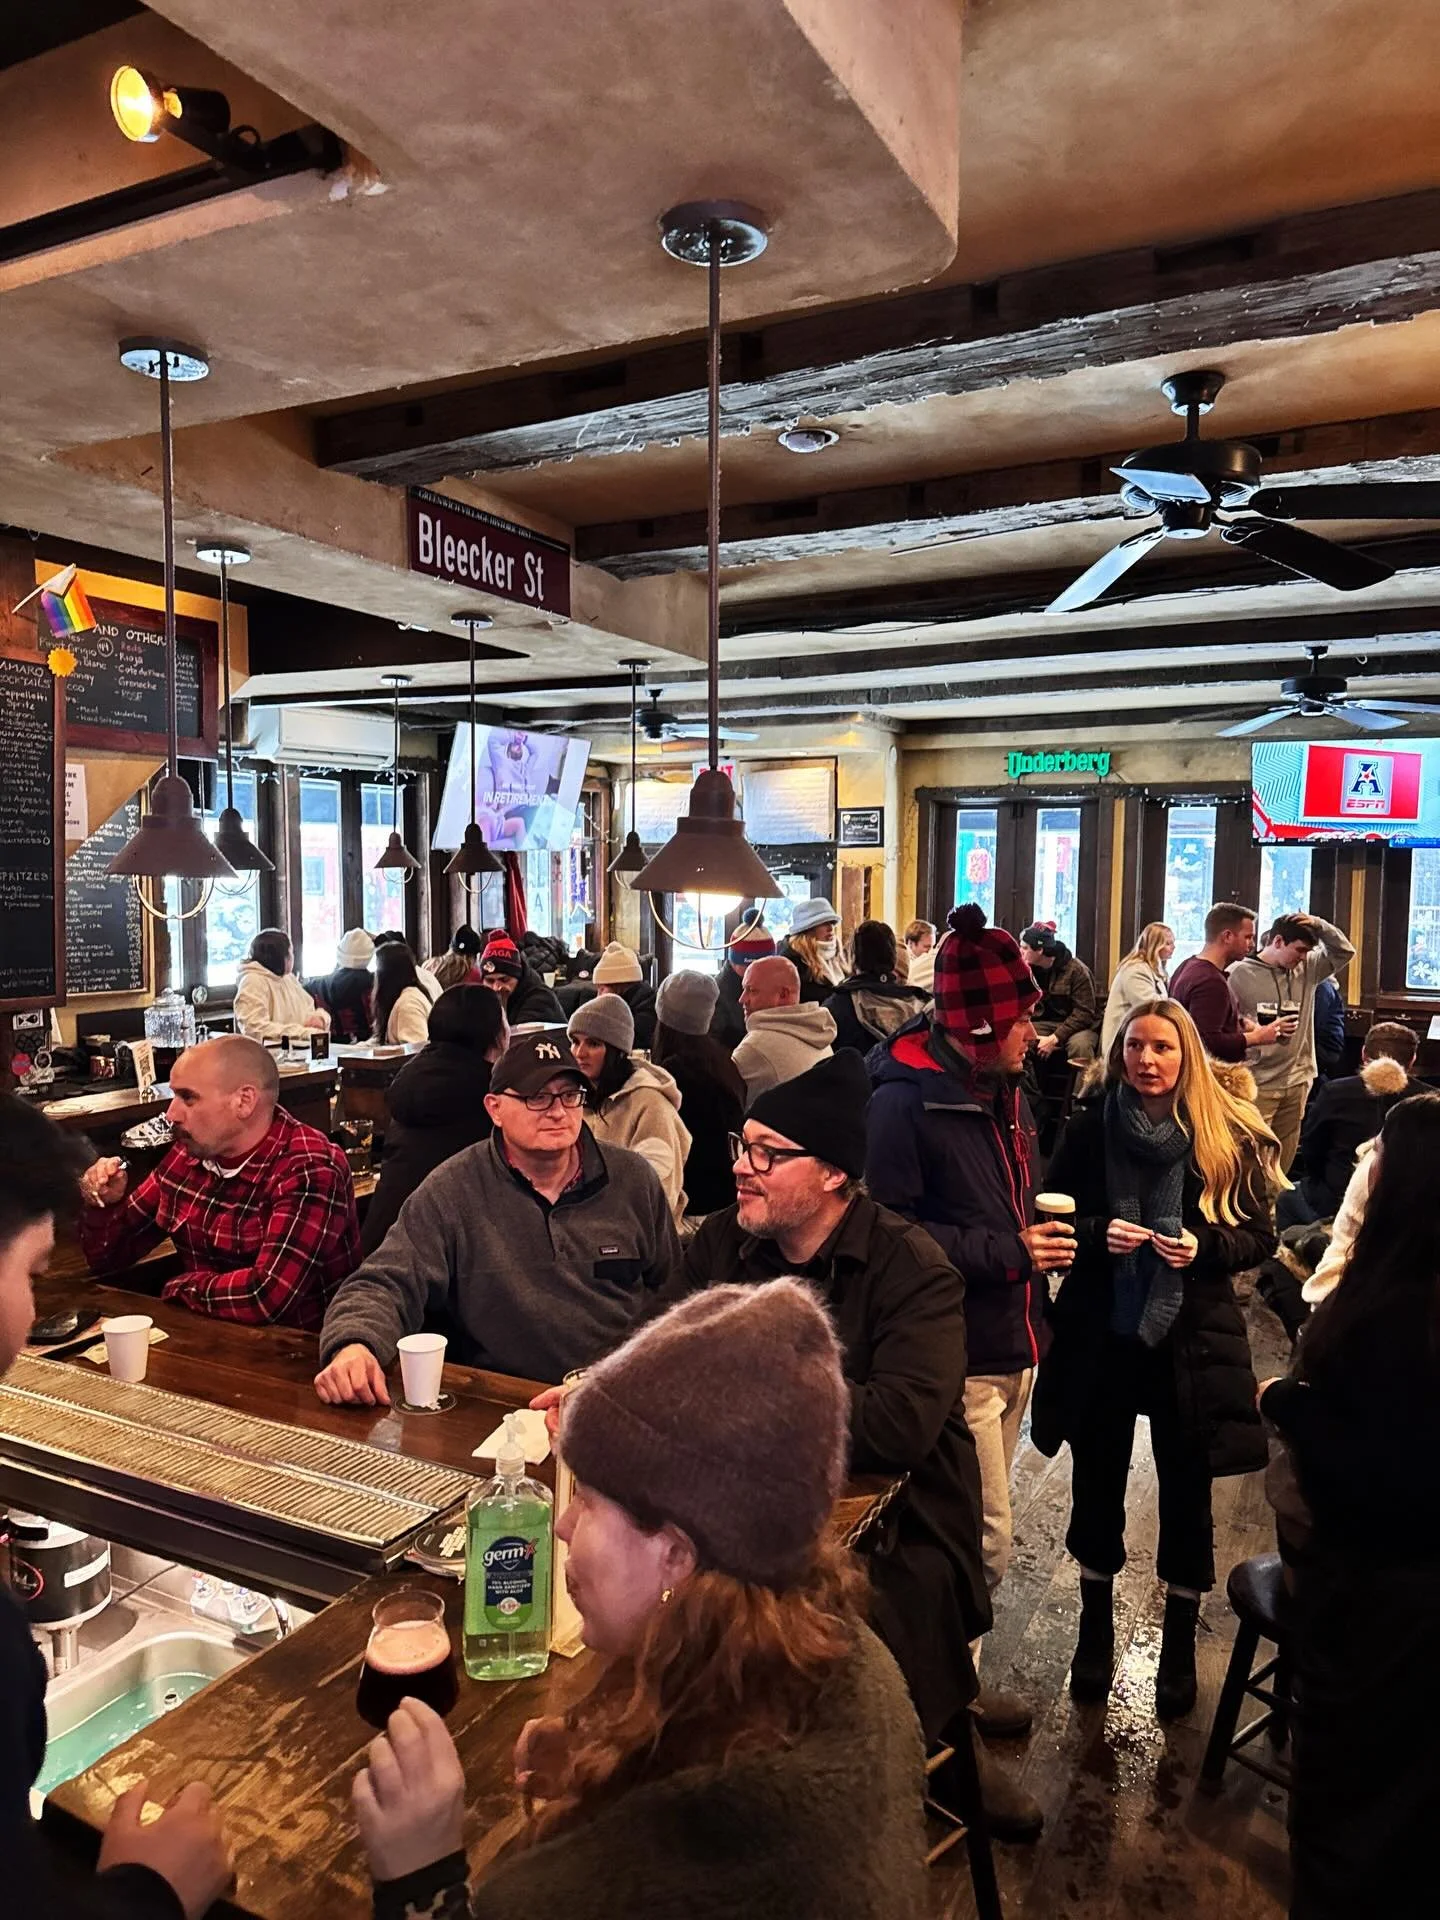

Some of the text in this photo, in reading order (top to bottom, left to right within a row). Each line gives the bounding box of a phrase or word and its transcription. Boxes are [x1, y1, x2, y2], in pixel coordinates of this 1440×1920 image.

[419, 512, 544, 601] Bleecker St
[92, 623, 119, 637] AND
[120, 652, 144, 667] Rioja
[1008, 749, 1110, 778] Underberg
[482, 790, 495, 803] IN
[1346, 799, 1386, 809] ESPN
[535, 1042, 561, 1059] NY
